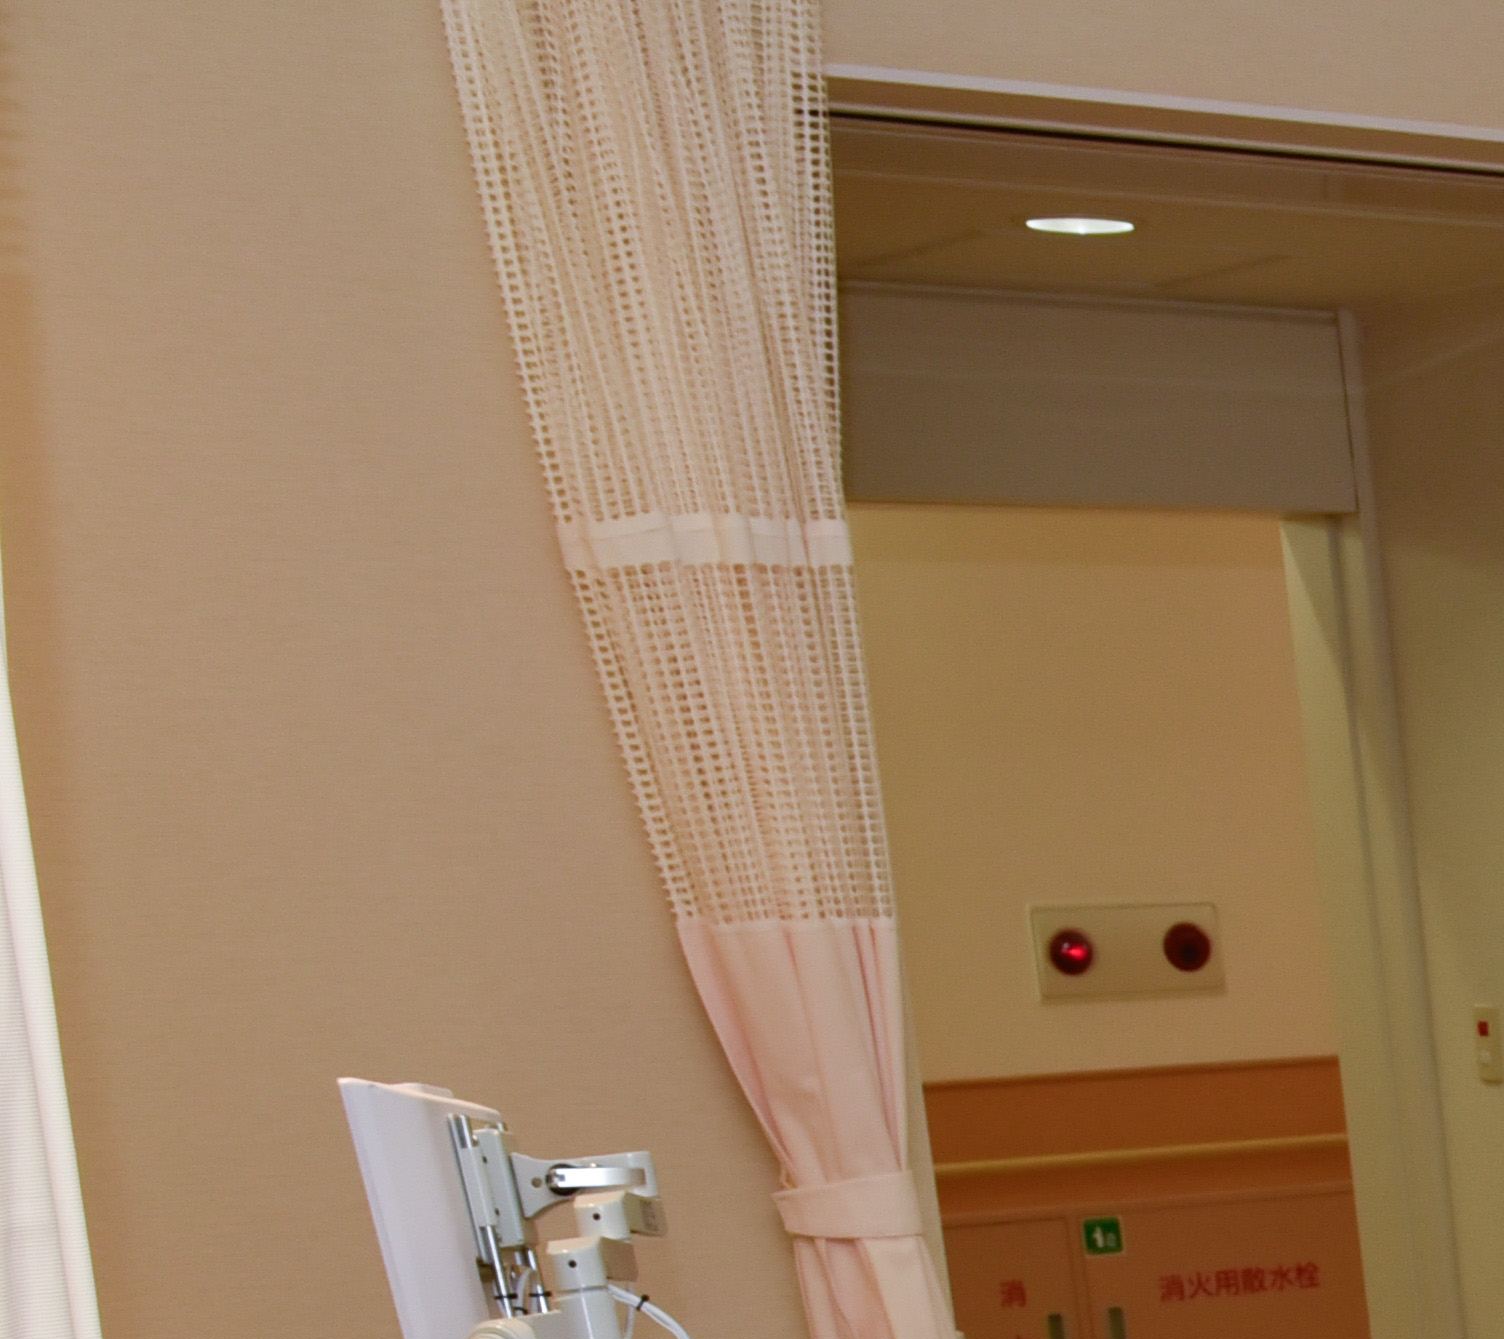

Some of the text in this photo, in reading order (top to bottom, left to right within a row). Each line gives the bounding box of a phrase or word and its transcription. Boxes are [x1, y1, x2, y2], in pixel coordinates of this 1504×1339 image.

[1159, 1262, 1320, 1303] 消火用散水栓
